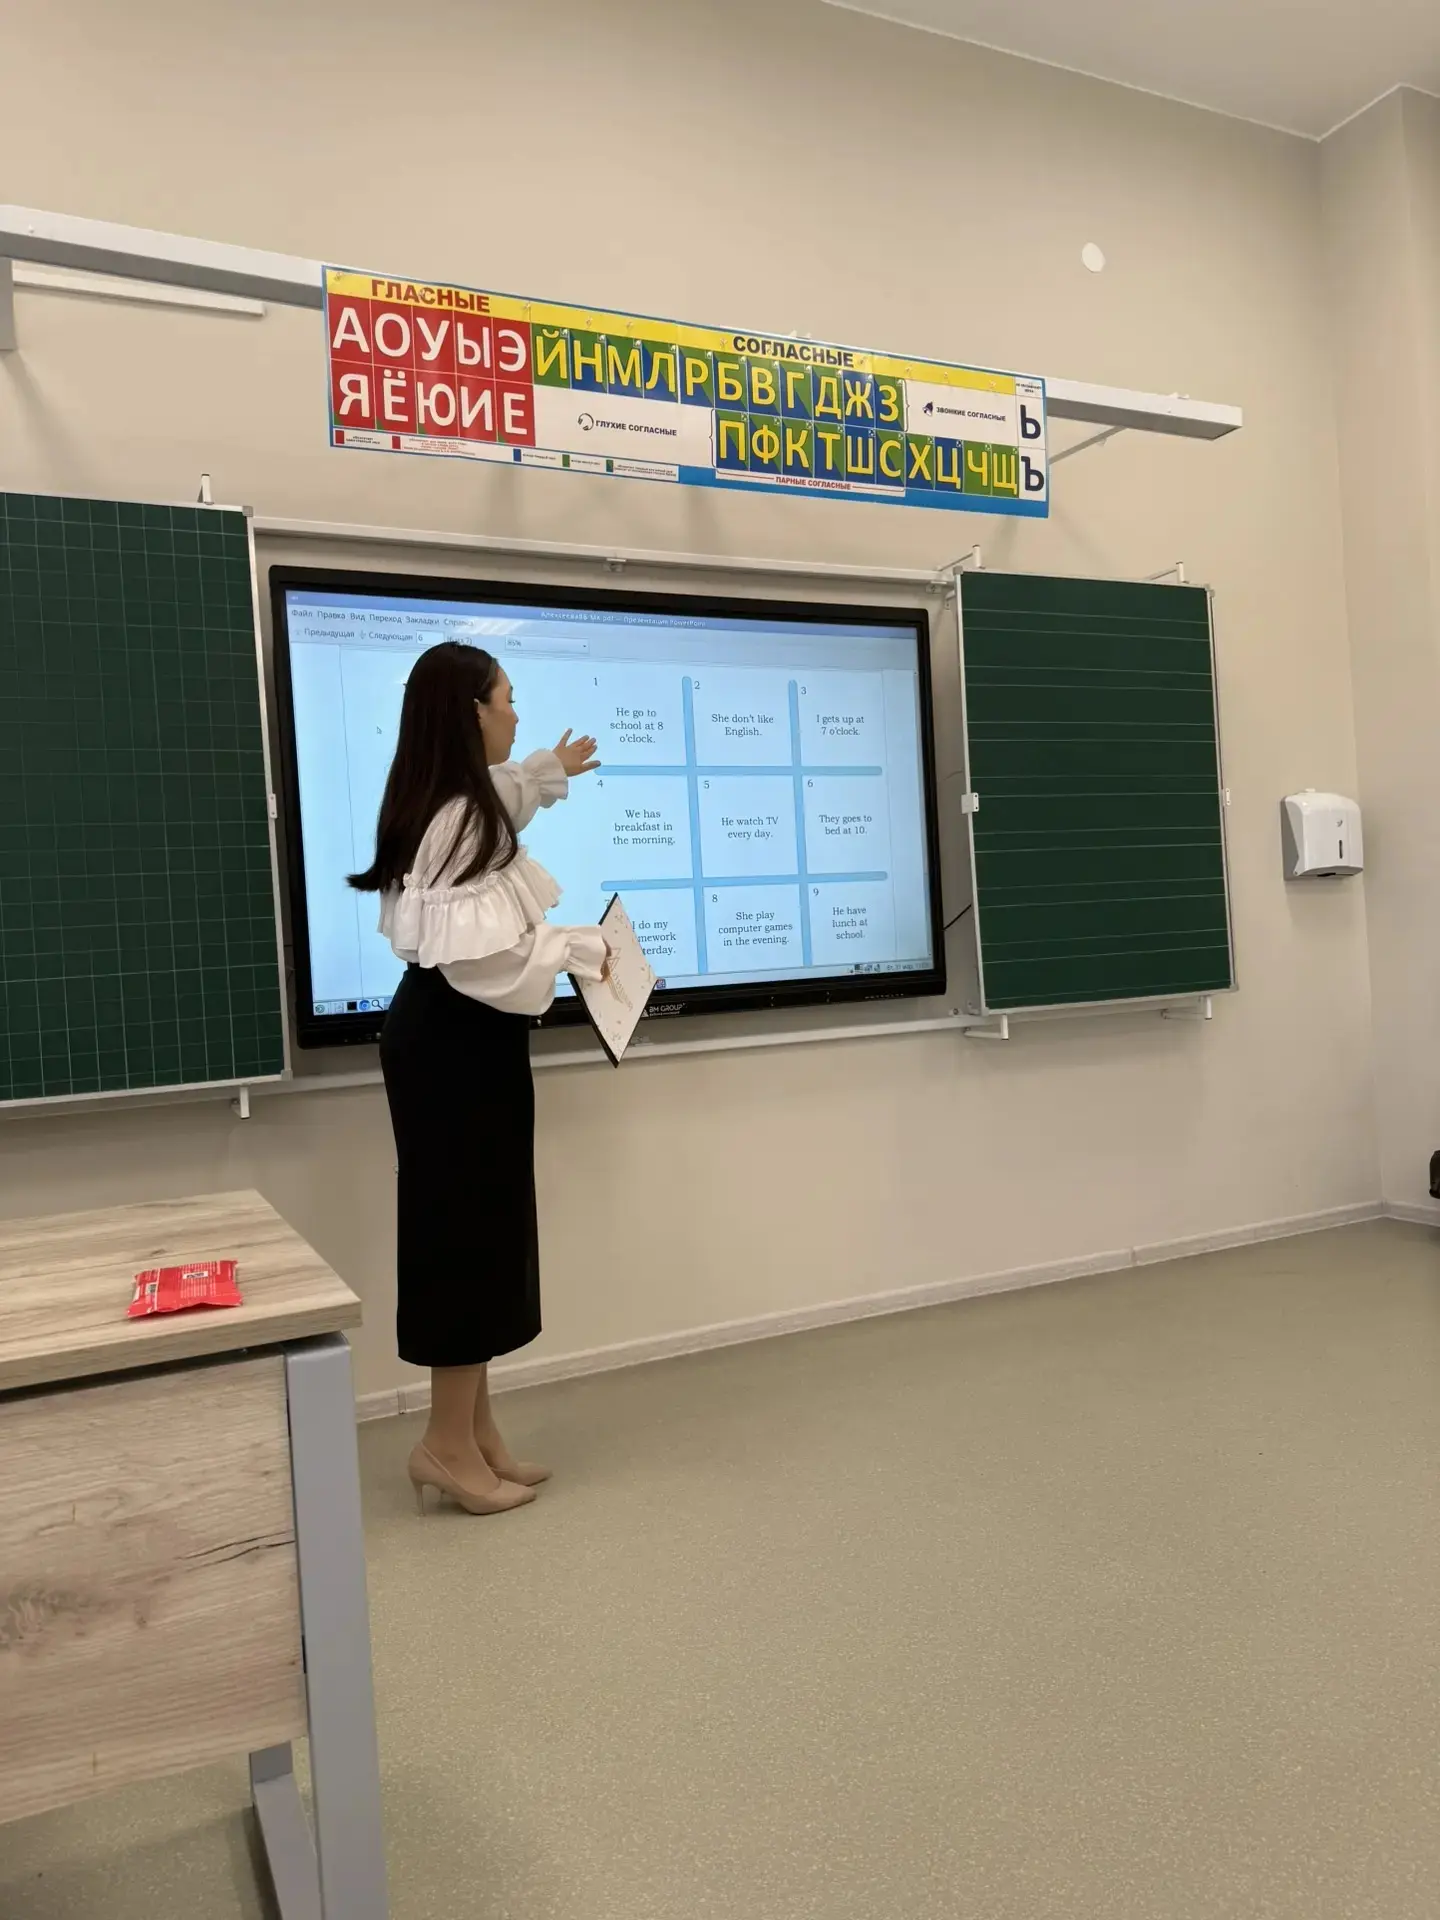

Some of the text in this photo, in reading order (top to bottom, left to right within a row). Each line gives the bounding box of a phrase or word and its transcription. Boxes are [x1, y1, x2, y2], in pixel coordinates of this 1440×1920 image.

[371, 279, 490, 313] ГЛАСНЫЕ
[733, 336, 854, 368] СОГЛАСНЫЕ
[936, 406, 1006, 422] ЗВОНКИЕ СОГЛАСНЫЕ
[595, 419, 677, 436] ГЛУХИЕ СОГЛАСНЫЕ
[776, 476, 852, 490] ПАРНЫЕ СОГЛАСНЫЕ
[291, 609, 474, 628] Файл Правка Вид Переход Закладки Справка
[304, 628, 355, 638] Предыдущая
[368, 631, 413, 641] Следующая
[594, 677, 598, 686] 1
[694, 680, 700, 690] 2
[801, 686, 807, 695] 3
[616, 707, 657, 719] He go to
[711, 714, 774, 724] She don't like
[822, 715, 840, 726] gets
[842, 716, 854, 726] up
[856, 716, 864, 724] at
[610, 720, 642, 730] school
[657, 721, 664, 730] 8
[725, 726, 763, 738] English.
[821, 726, 860, 736] 7 o'clock.
[620, 734, 656, 743] o'clock.
[597, 779, 604, 788] 4
[704, 780, 710, 790] 5
[807, 779, 814, 788] 6
[625, 809, 661, 819] We has
[722, 816, 779, 826] He watch TV
[818, 814, 872, 825] They goes to
[614, 821, 673, 832] breakfast in
[825, 826, 841, 835] bed
[855, 825, 868, 835] 10.
[728, 829, 773, 840] every day.
[613, 835, 676, 846] the morning.
[813, 888, 819, 896] 9
[712, 894, 718, 903] 8
[832, 906, 867, 916] He have
[736, 911, 775, 922] She play
[638, 921, 651, 930] do
[654, 921, 668, 931] my
[832, 918, 868, 928] lunch at
[719, 924, 793, 936] computer games
[836, 930, 866, 940] school.
[638, 932, 677, 942] mework
[723, 935, 789, 947] in the evening.
